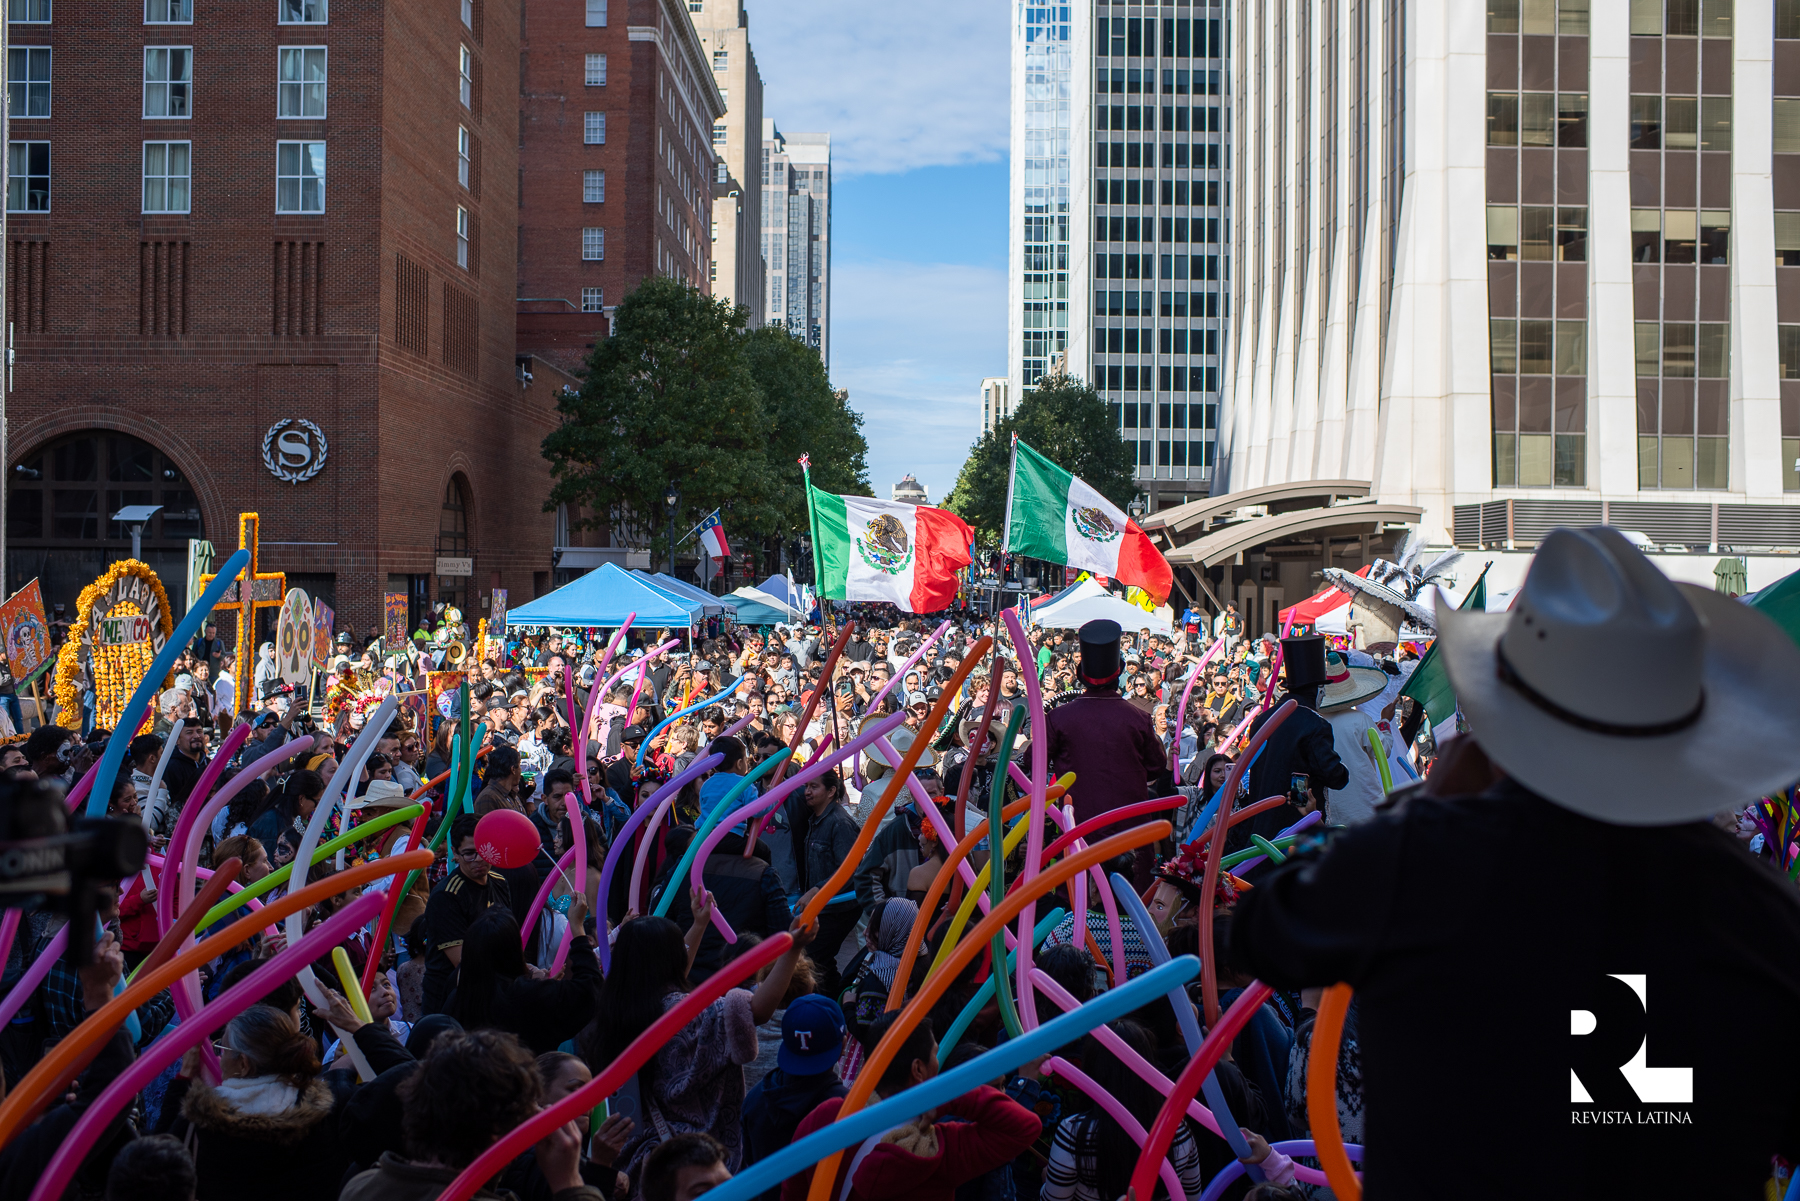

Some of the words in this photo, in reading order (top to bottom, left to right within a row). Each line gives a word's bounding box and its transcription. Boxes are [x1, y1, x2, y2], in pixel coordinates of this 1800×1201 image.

[437, 561, 460, 569] Jimmy
[117, 576, 140, 601] LA
[103, 618, 149, 644] MEXICO
[794, 1030, 813, 1050] T
